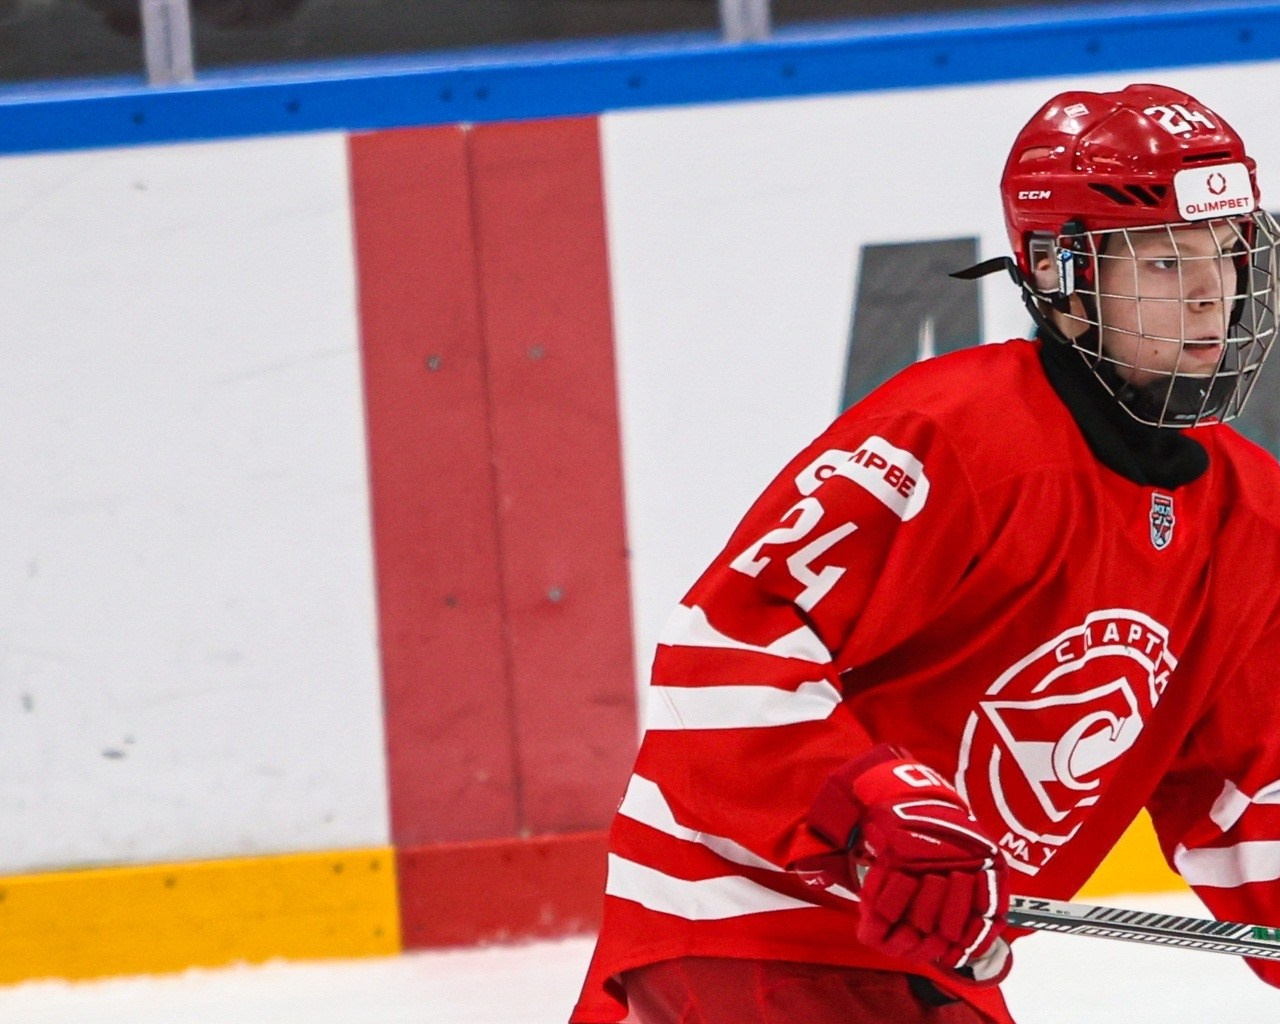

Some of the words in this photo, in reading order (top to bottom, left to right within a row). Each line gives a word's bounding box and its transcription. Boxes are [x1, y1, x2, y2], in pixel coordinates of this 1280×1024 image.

[1143, 104, 1216, 135] 24
[1018, 190, 1051, 200] CCM
[1186, 198, 1249, 214] OLIMPBET
[814, 449, 917, 499] OMPBE
[729, 497, 859, 613] 24
